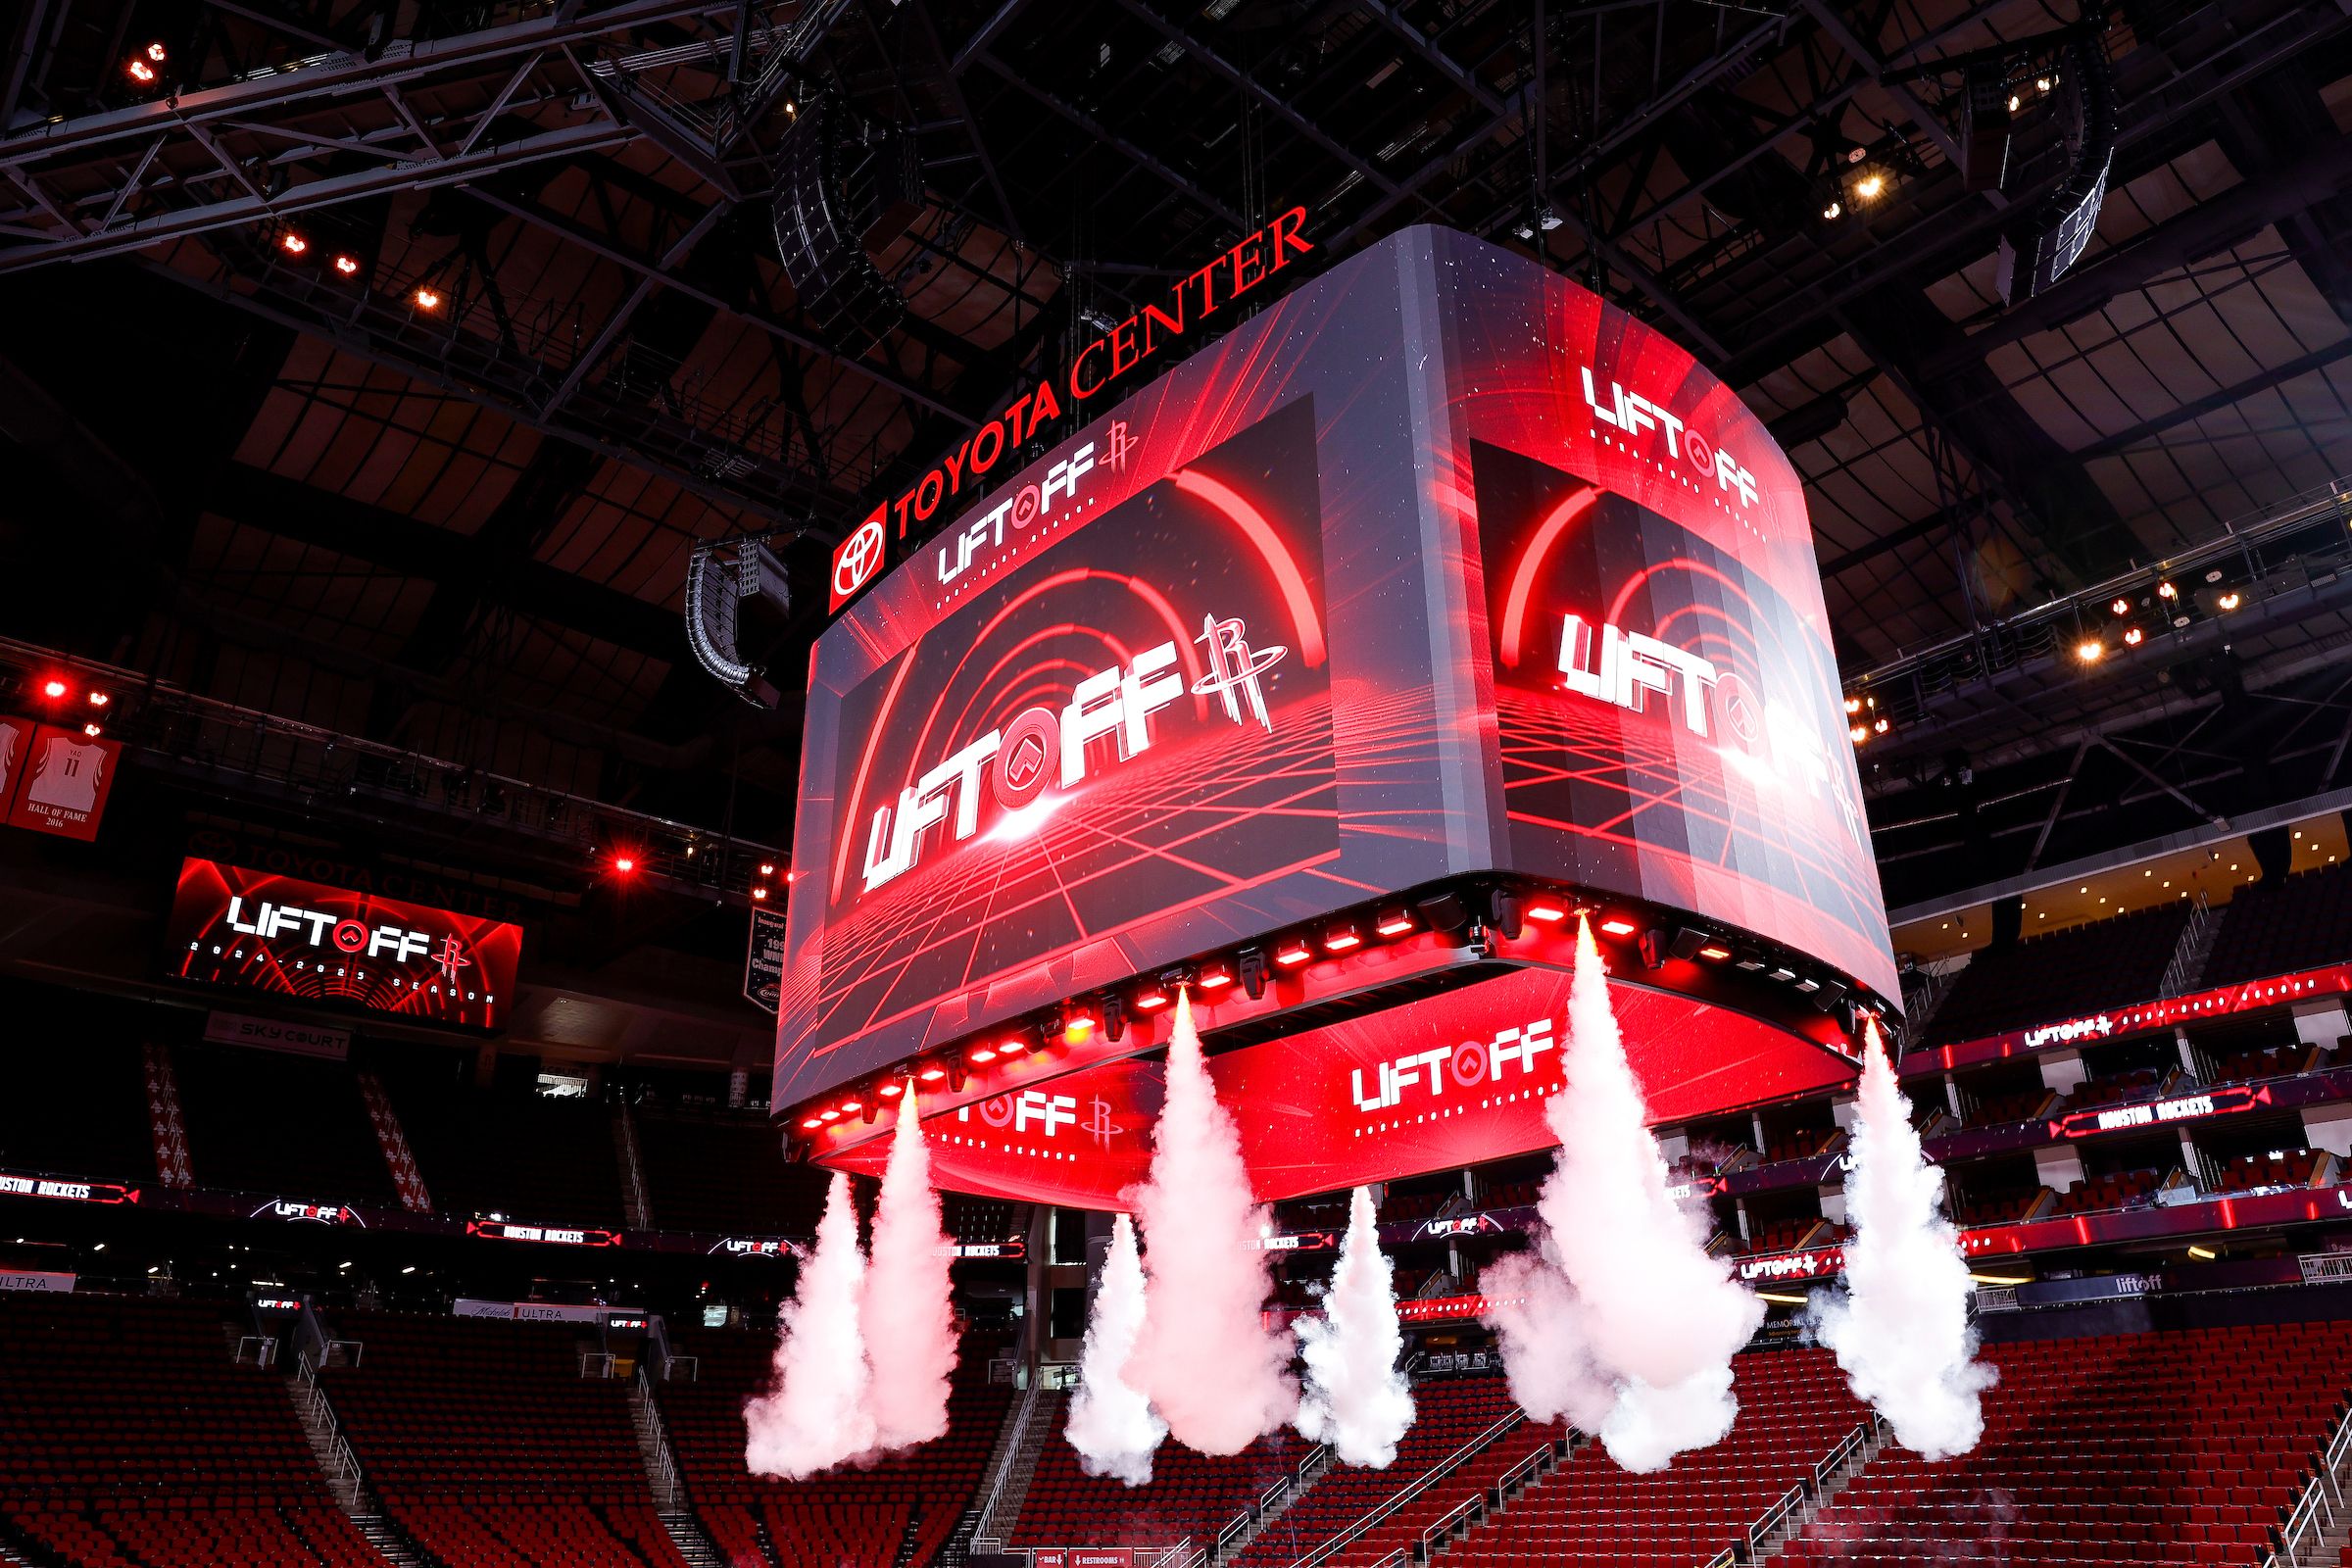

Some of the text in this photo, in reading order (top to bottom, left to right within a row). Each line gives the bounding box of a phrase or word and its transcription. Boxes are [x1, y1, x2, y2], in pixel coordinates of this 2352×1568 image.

[895, 206, 1314, 539] TOYOTA CENTER
[1581, 366, 1759, 509] LIFTOFF
[938, 441, 1095, 585] LIFTOFF
[70, 749, 82, 758] YAO
[65, 758, 79, 777] 11
[862, 641, 1184, 892] LIFTOFF
[27, 803, 87, 822] HALL OF FAME
[46, 817, 64, 828] 2016
[226, 896, 429, 962] LIFTOFF
[190, 941, 495, 1005] 2024-2025 SEASON
[752, 957, 782, 977] Champ
[239, 1023, 282, 1039] SKY
[284, 1031, 346, 1049] COURT
[1351, 1018, 1554, 1112] LIFTOFF
[37, 1181, 90, 1200] ROCKETS
[274, 1202, 337, 1219] LIFTOFF
[726, 1240, 779, 1252] LIFTOFF
[521, 1308, 563, 1320] ULTRA
[1043, 1555, 1057, 1565] BAR
[1081, 1556, 1118, 1565] RESTROOMS
